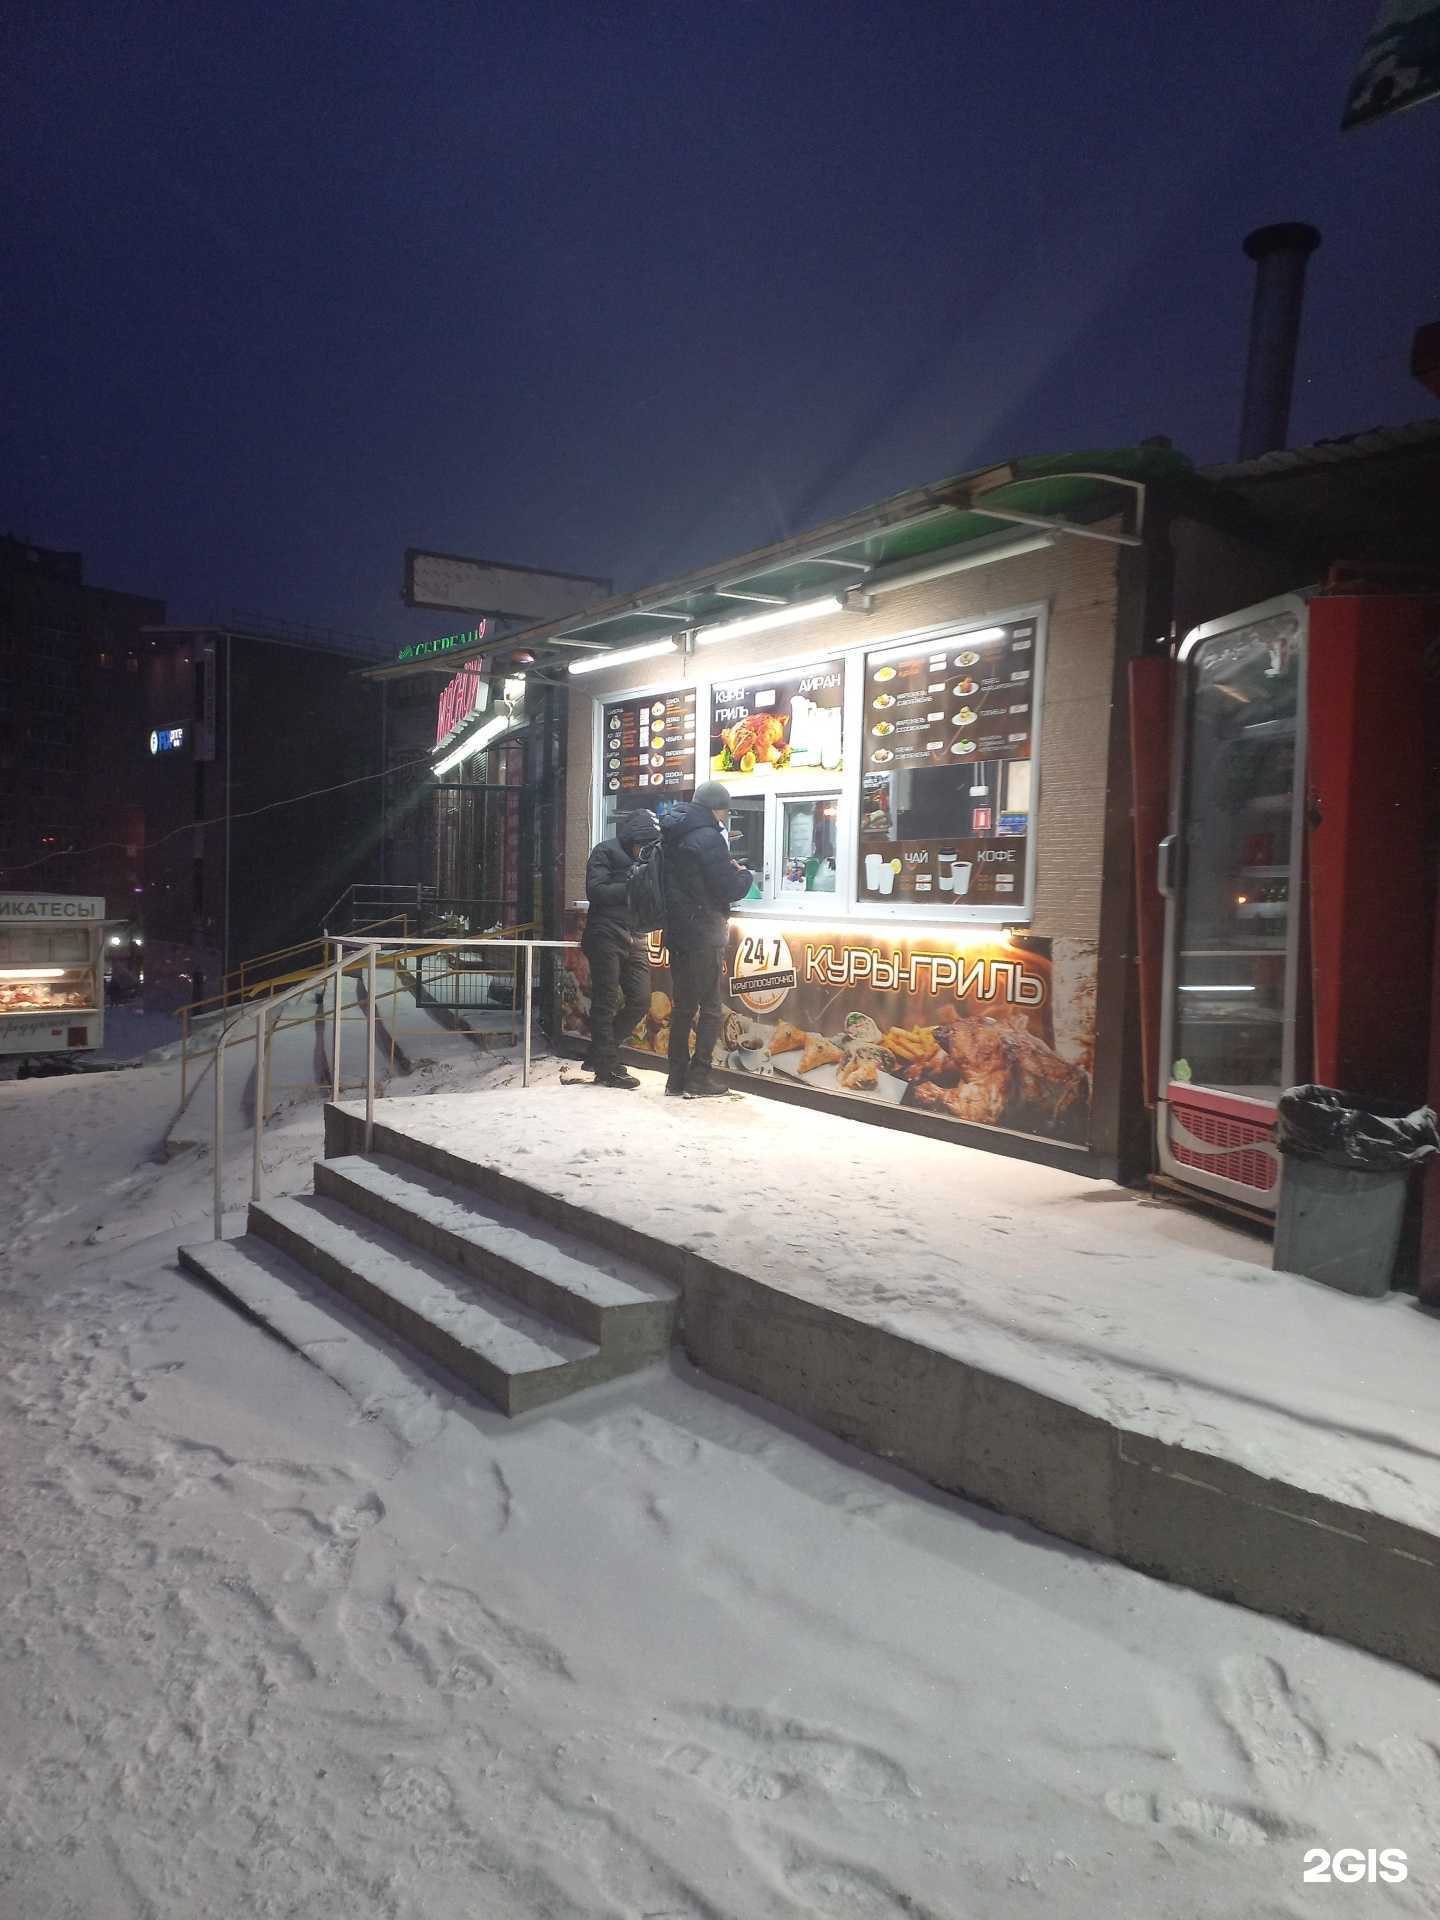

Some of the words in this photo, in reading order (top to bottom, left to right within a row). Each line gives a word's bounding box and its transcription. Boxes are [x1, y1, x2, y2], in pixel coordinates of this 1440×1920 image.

[715, 706, 749, 722] ГРИЛЬ
[904, 849, 929, 864] ЧАЙ
[977, 849, 1017, 863] КОФЕ
[805, 944, 1045, 1005] КУРЫ-ГРИЛЬ
